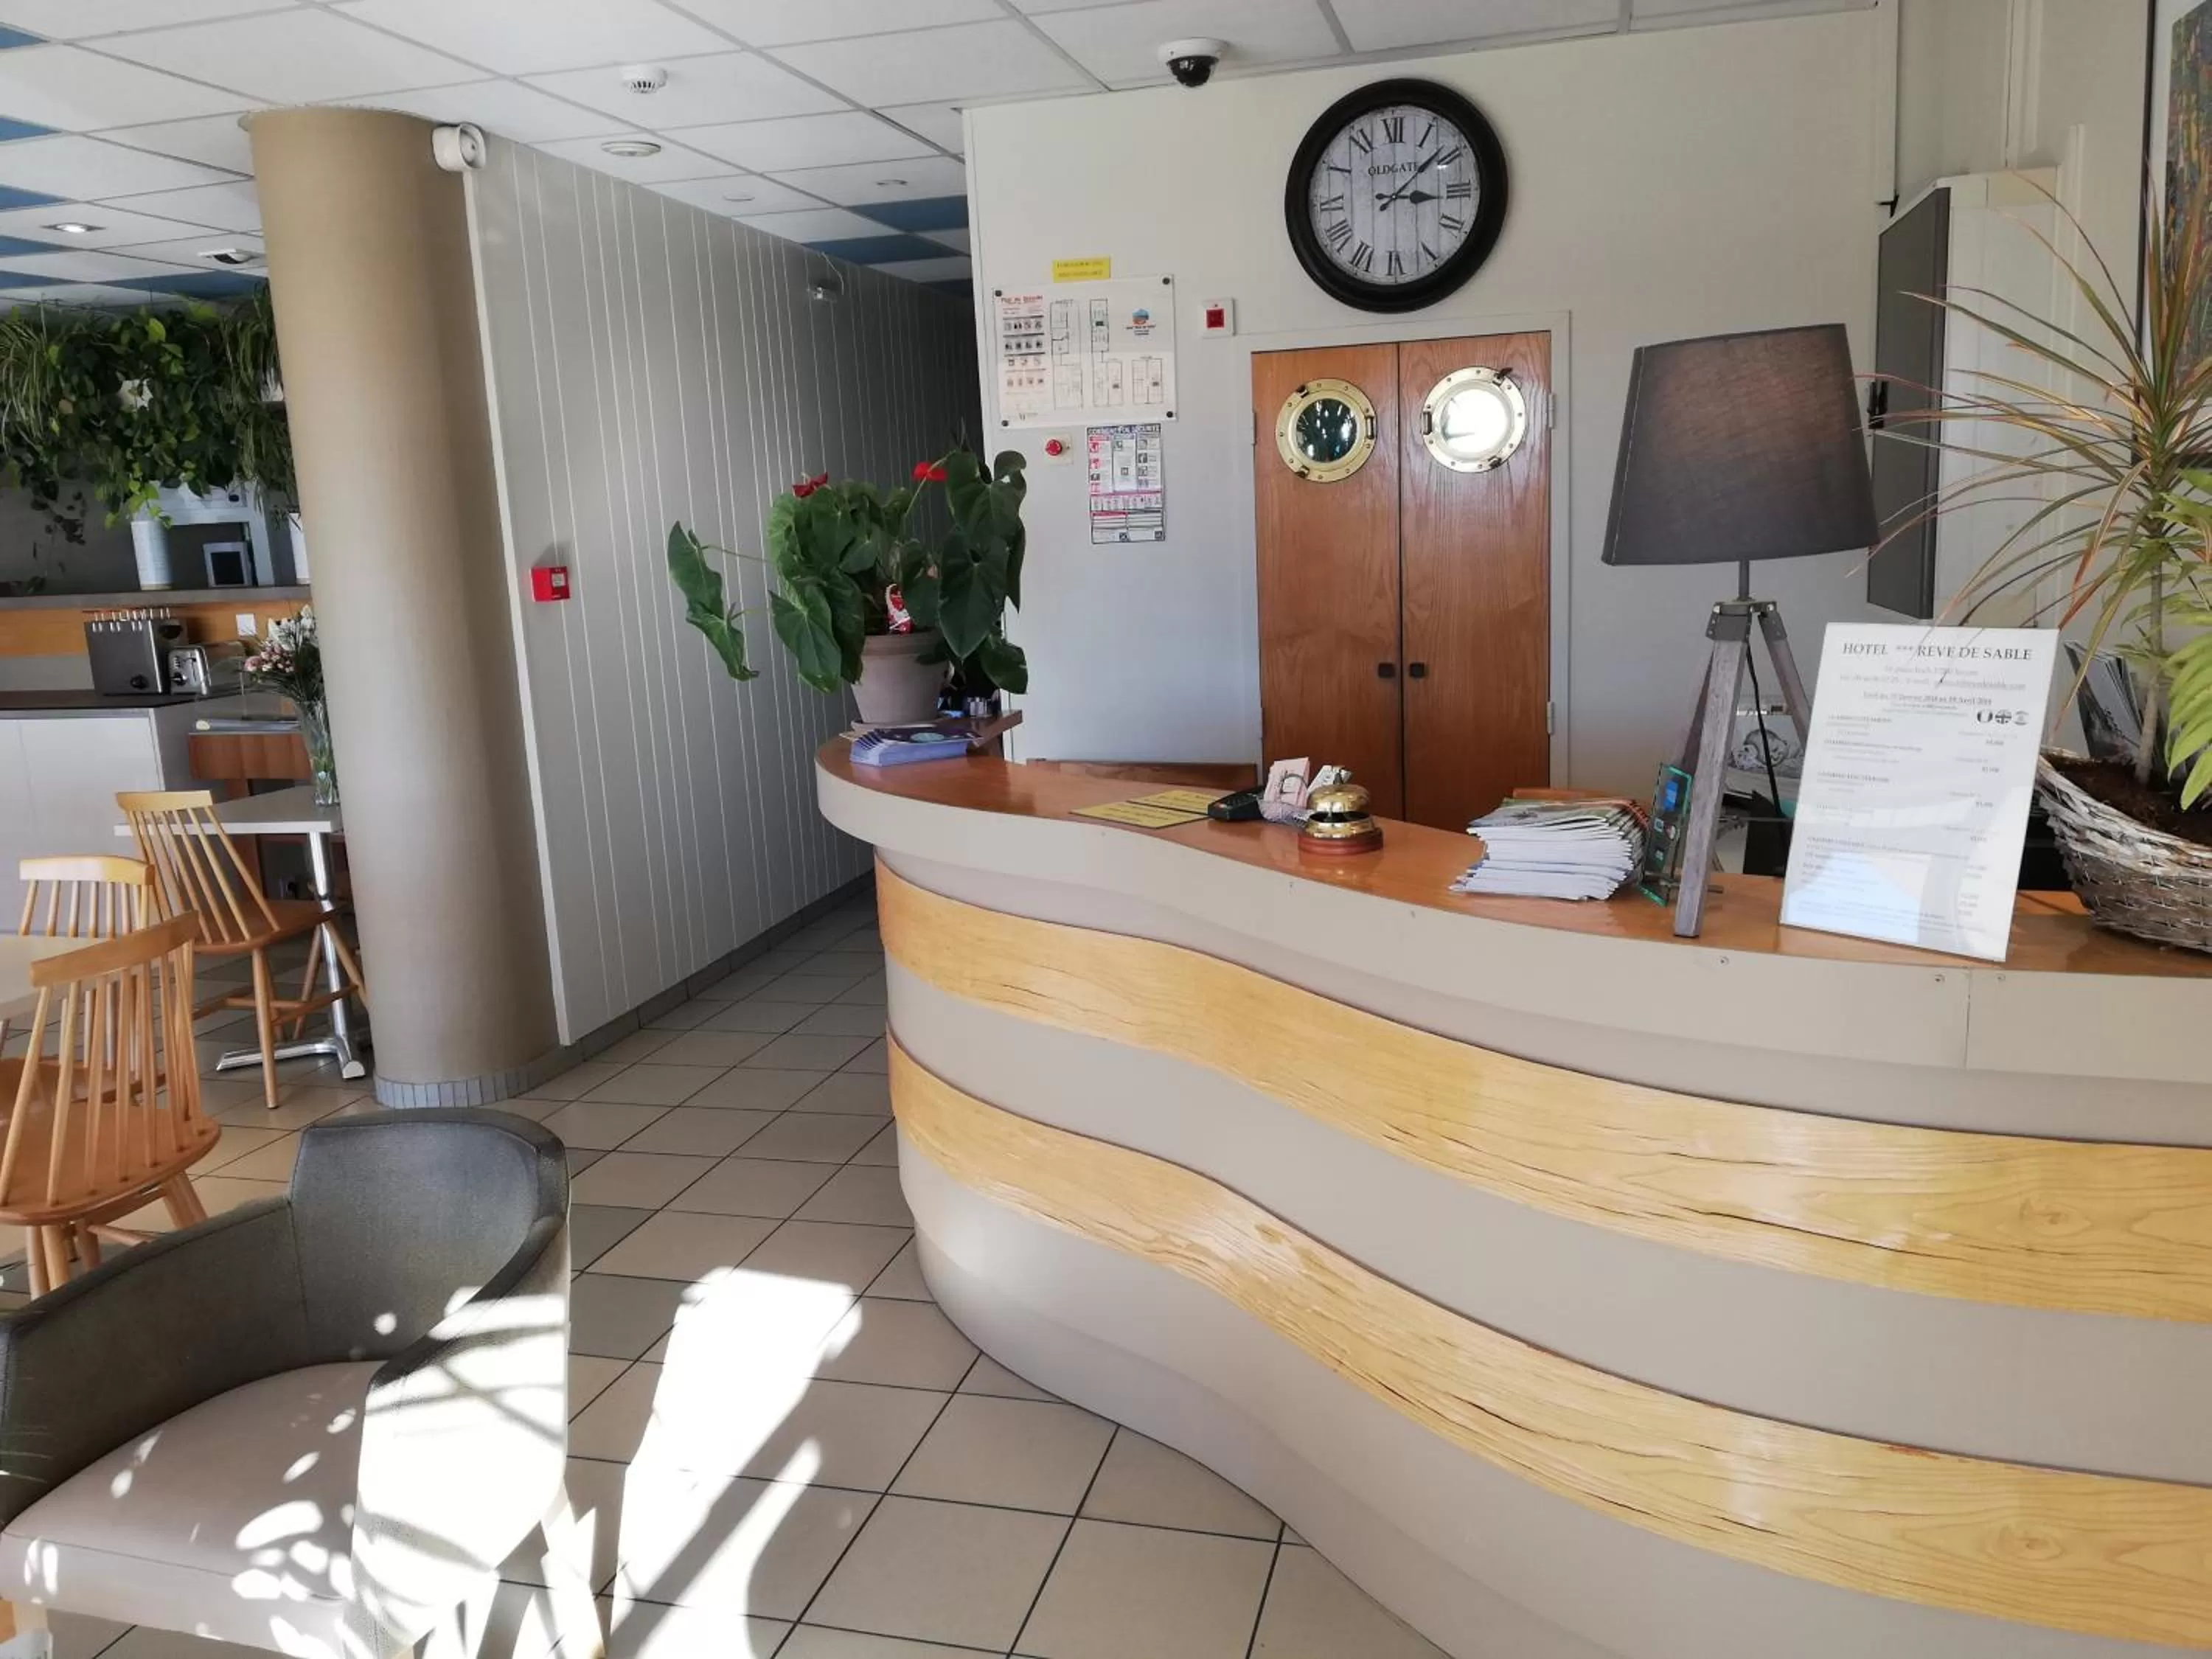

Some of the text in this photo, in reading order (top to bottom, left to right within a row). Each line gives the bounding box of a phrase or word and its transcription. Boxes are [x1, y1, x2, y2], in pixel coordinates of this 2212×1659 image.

[1380, 116, 1406, 144] XII
[1958, 646, 1980, 659] DE
[1982, 647, 2033, 661] SABLE
